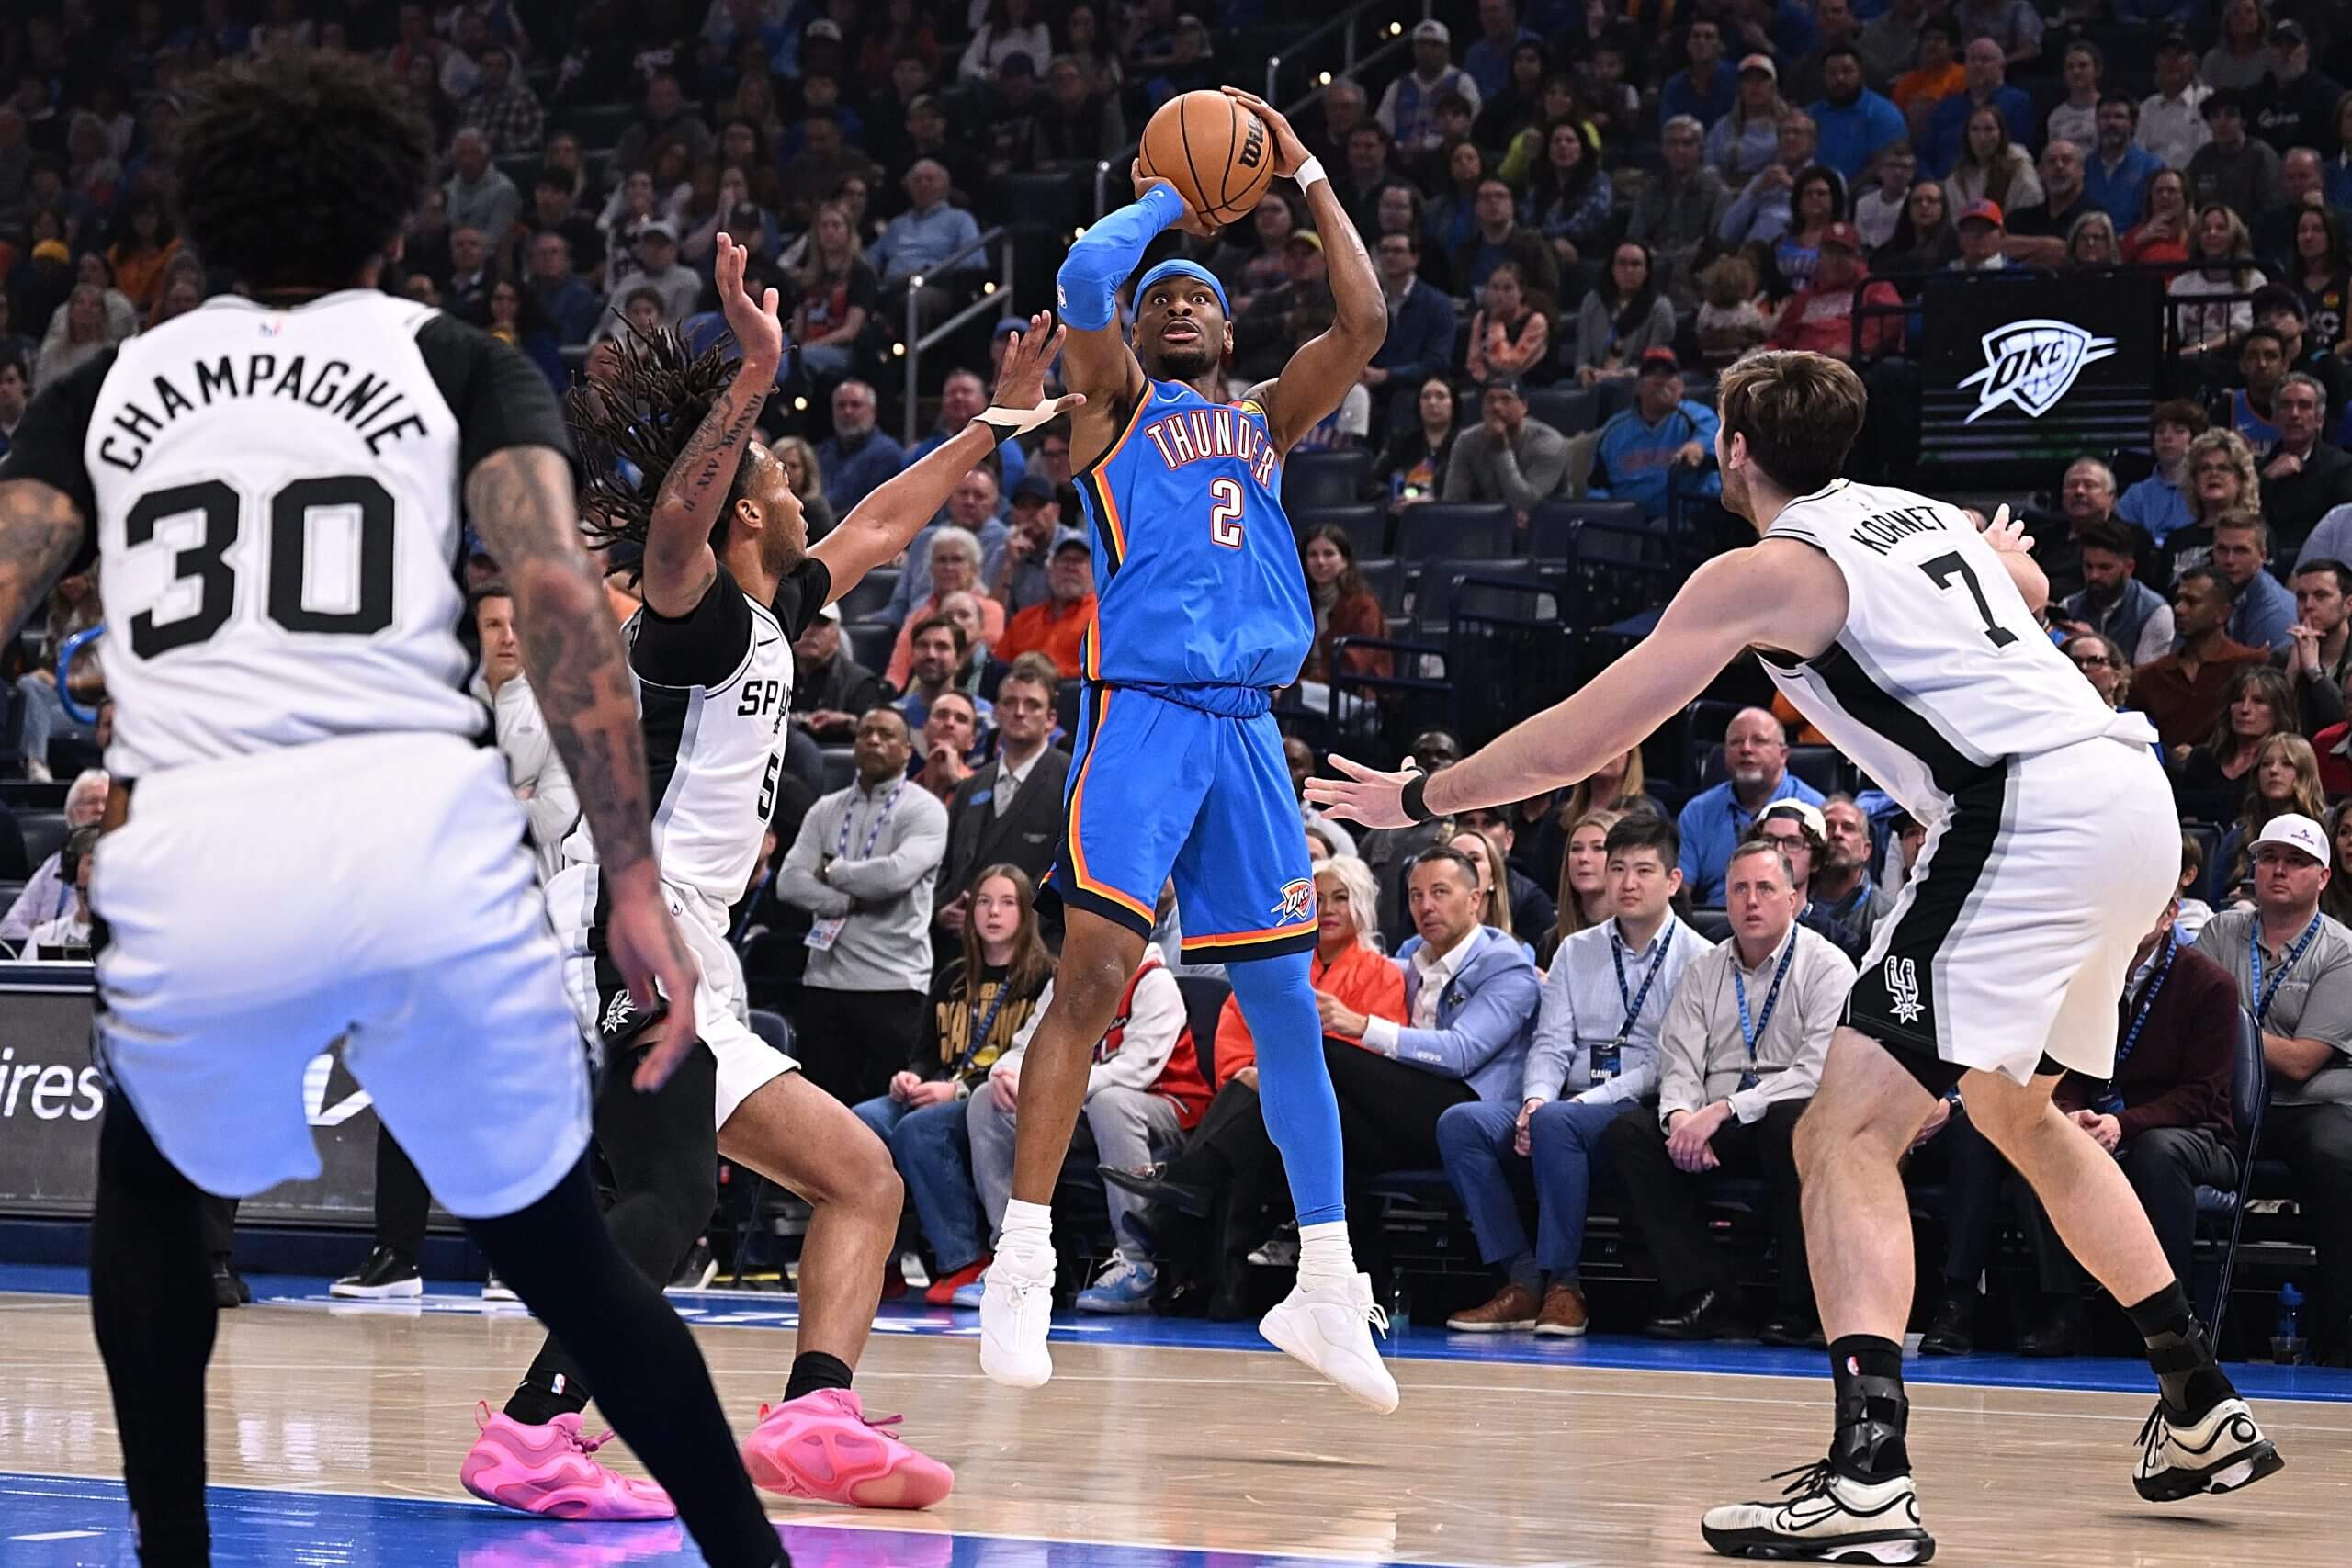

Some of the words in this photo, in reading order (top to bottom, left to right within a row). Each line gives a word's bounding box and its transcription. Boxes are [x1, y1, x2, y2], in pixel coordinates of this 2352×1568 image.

[1988, 340, 2064, 395] OKC
[100, 354, 429, 472] CHAMPAGNIE
[1145, 410, 1278, 489] THUNDER
[1210, 478, 1244, 549] 2
[1849, 506, 1947, 556] KORNET
[126, 475, 395, 660] 30
[1918, 550, 2019, 648] 7
[756, 750, 781, 823] 5
[0, 1047, 103, 1121] ires
